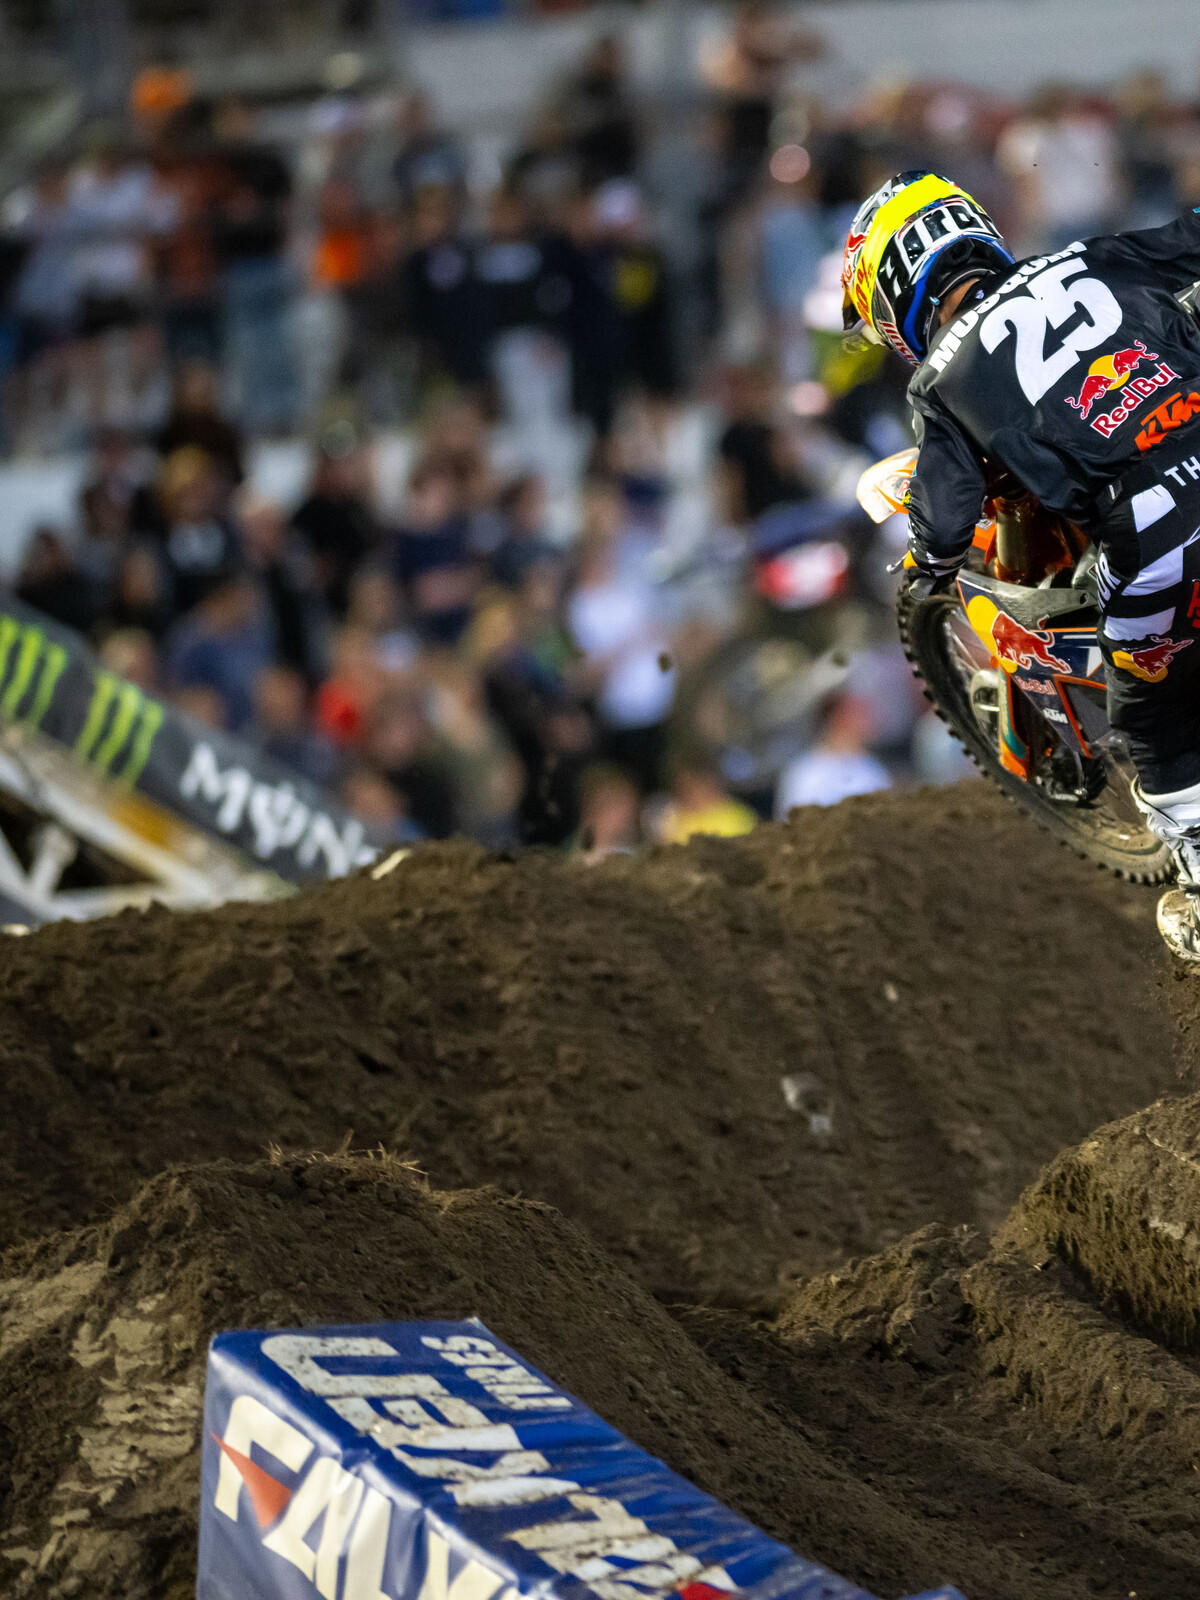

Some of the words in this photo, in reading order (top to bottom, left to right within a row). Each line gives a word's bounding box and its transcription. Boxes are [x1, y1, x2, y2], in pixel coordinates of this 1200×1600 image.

[979, 257, 1124, 406] 25
[1090, 386, 1144, 439] Red
[1043, 707, 1068, 724] KTM
